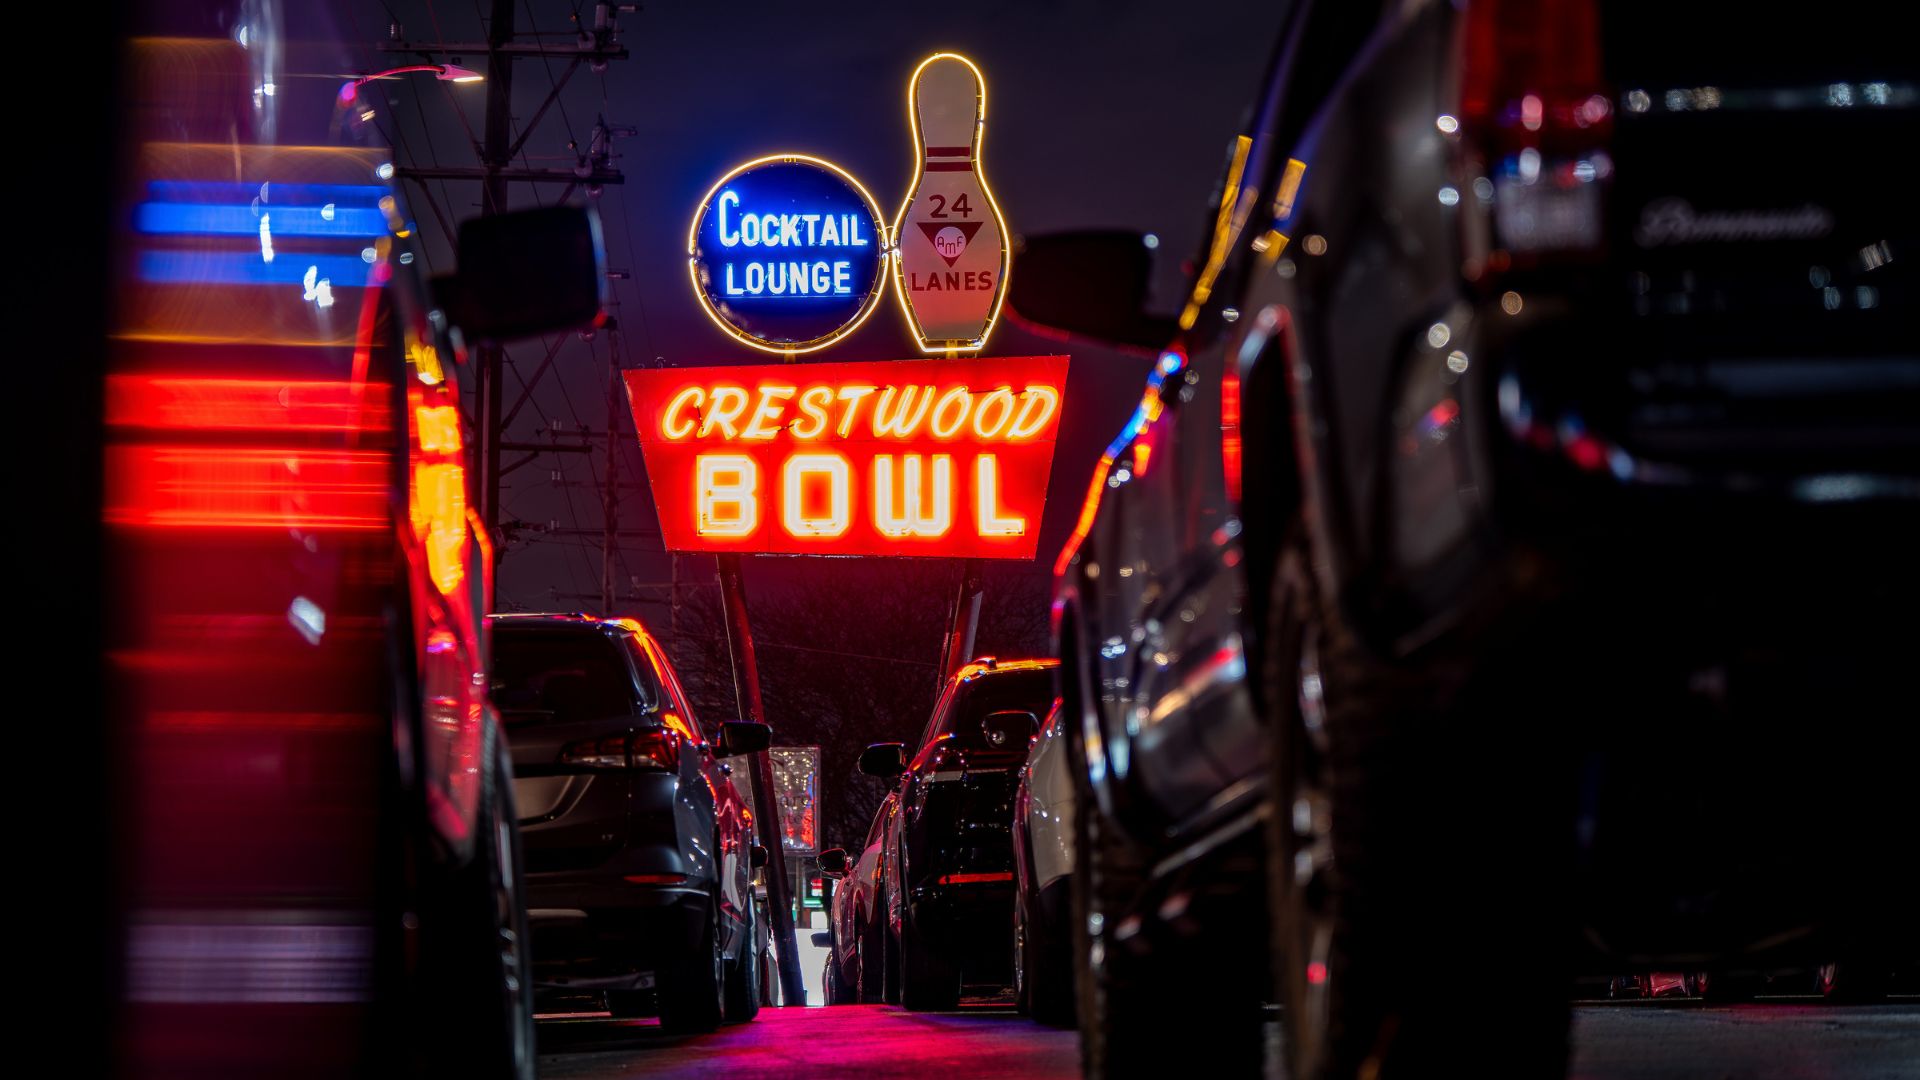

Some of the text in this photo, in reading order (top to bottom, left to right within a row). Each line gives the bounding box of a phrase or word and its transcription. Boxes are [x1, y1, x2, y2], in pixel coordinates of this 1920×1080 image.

[719, 190, 869, 247] COCKTAIL
[929, 192, 973, 218] 24
[726, 261, 851, 295] LOUNGE
[911, 270, 993, 291] LANES
[661, 384, 1059, 441] CRESTWOOD
[696, 453, 1025, 537] BOWL
